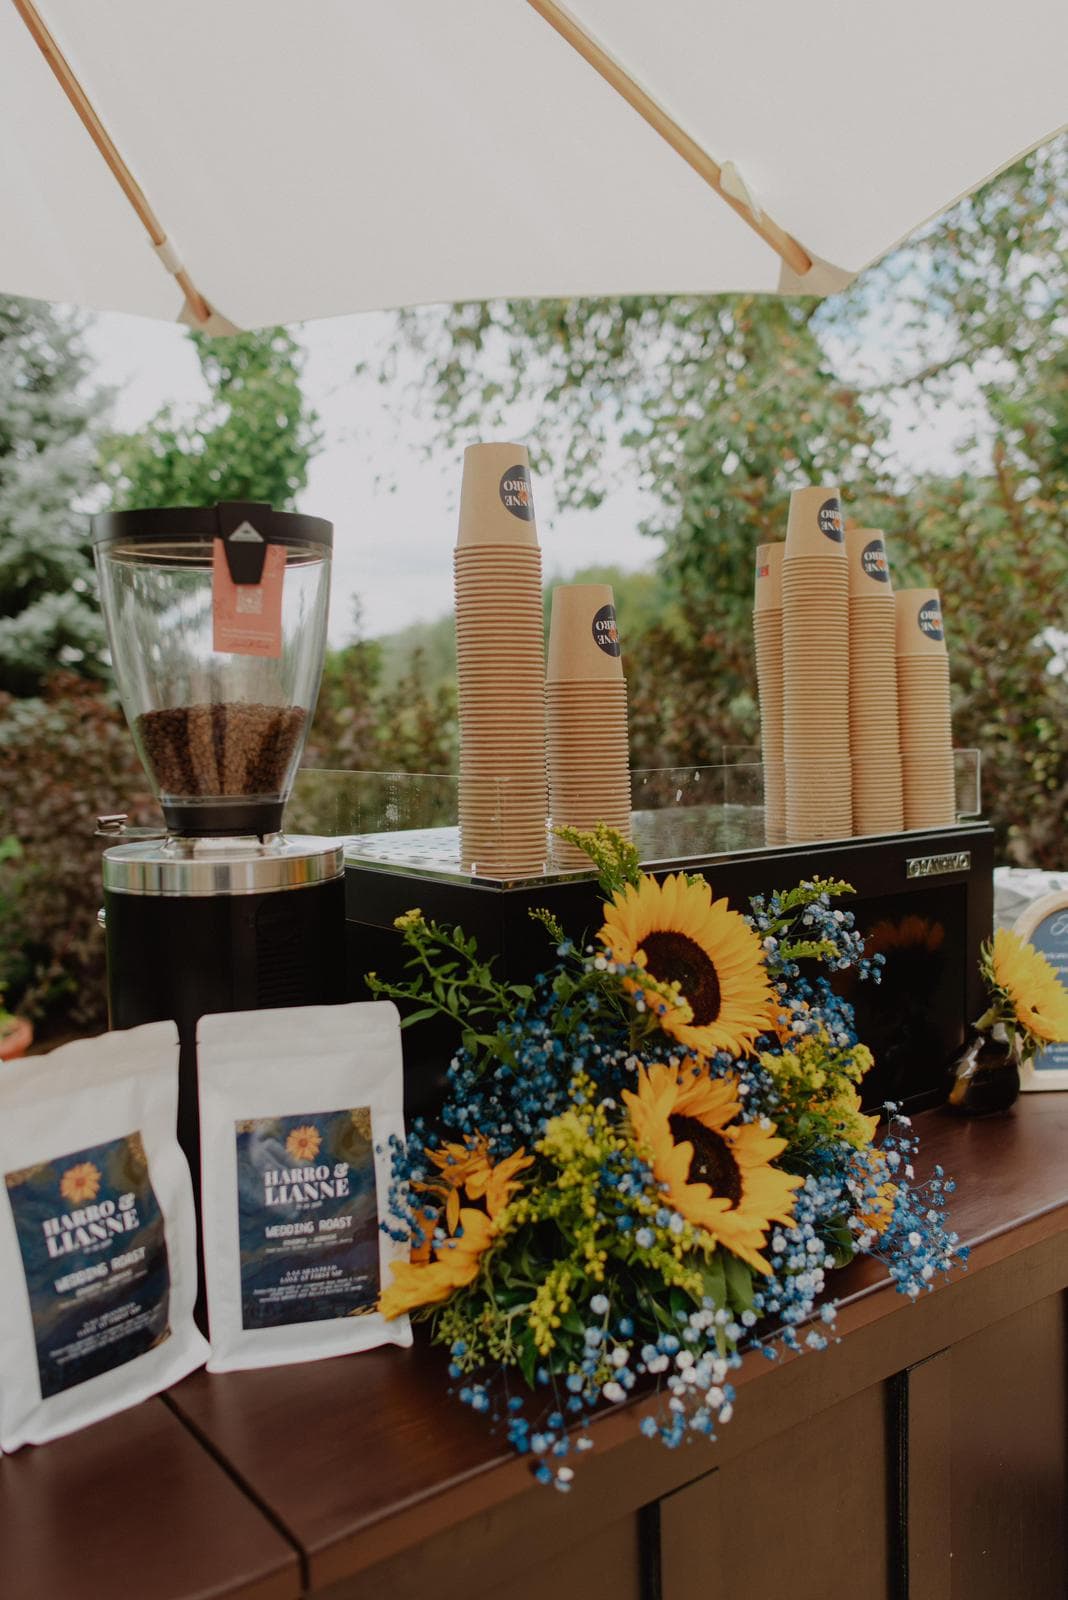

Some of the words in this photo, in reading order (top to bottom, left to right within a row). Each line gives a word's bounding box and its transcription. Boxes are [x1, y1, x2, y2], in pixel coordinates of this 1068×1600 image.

[264, 1165, 330, 1186] HARRO
[333, 1162, 350, 1179] &
[265, 1178, 350, 1206] LIANNE
[42, 1200, 115, 1237] HARRO
[118, 1192, 136, 1211] &
[264, 1221, 315, 1239] WEDDING
[319, 1216, 353, 1232] ROAST
[47, 1208, 140, 1258] LIANNE
